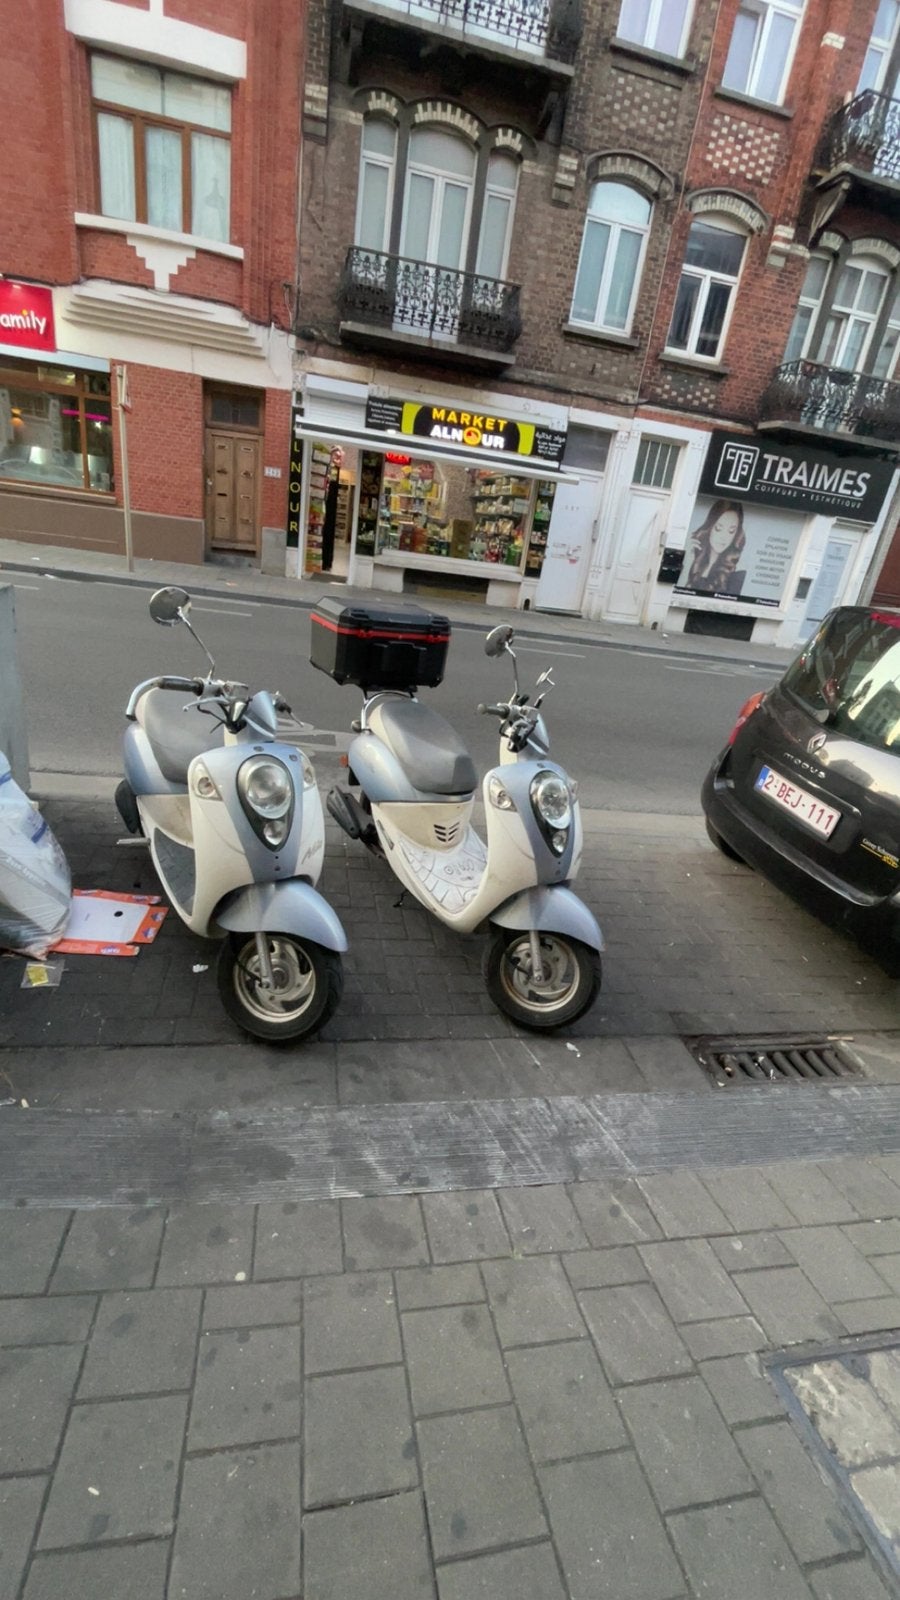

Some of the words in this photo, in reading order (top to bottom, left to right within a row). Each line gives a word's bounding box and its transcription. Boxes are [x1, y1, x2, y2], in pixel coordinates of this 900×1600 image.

[430, 424, 505, 449] ALNOUR
[432, 407, 508, 432] MARKET
[289, 441, 302, 533] LNOUR
[754, 484, 798, 498] COIFFURE
[763, 453, 872, 498] TRAIMES
[764, 774, 835, 831] 2-BEJ-111
